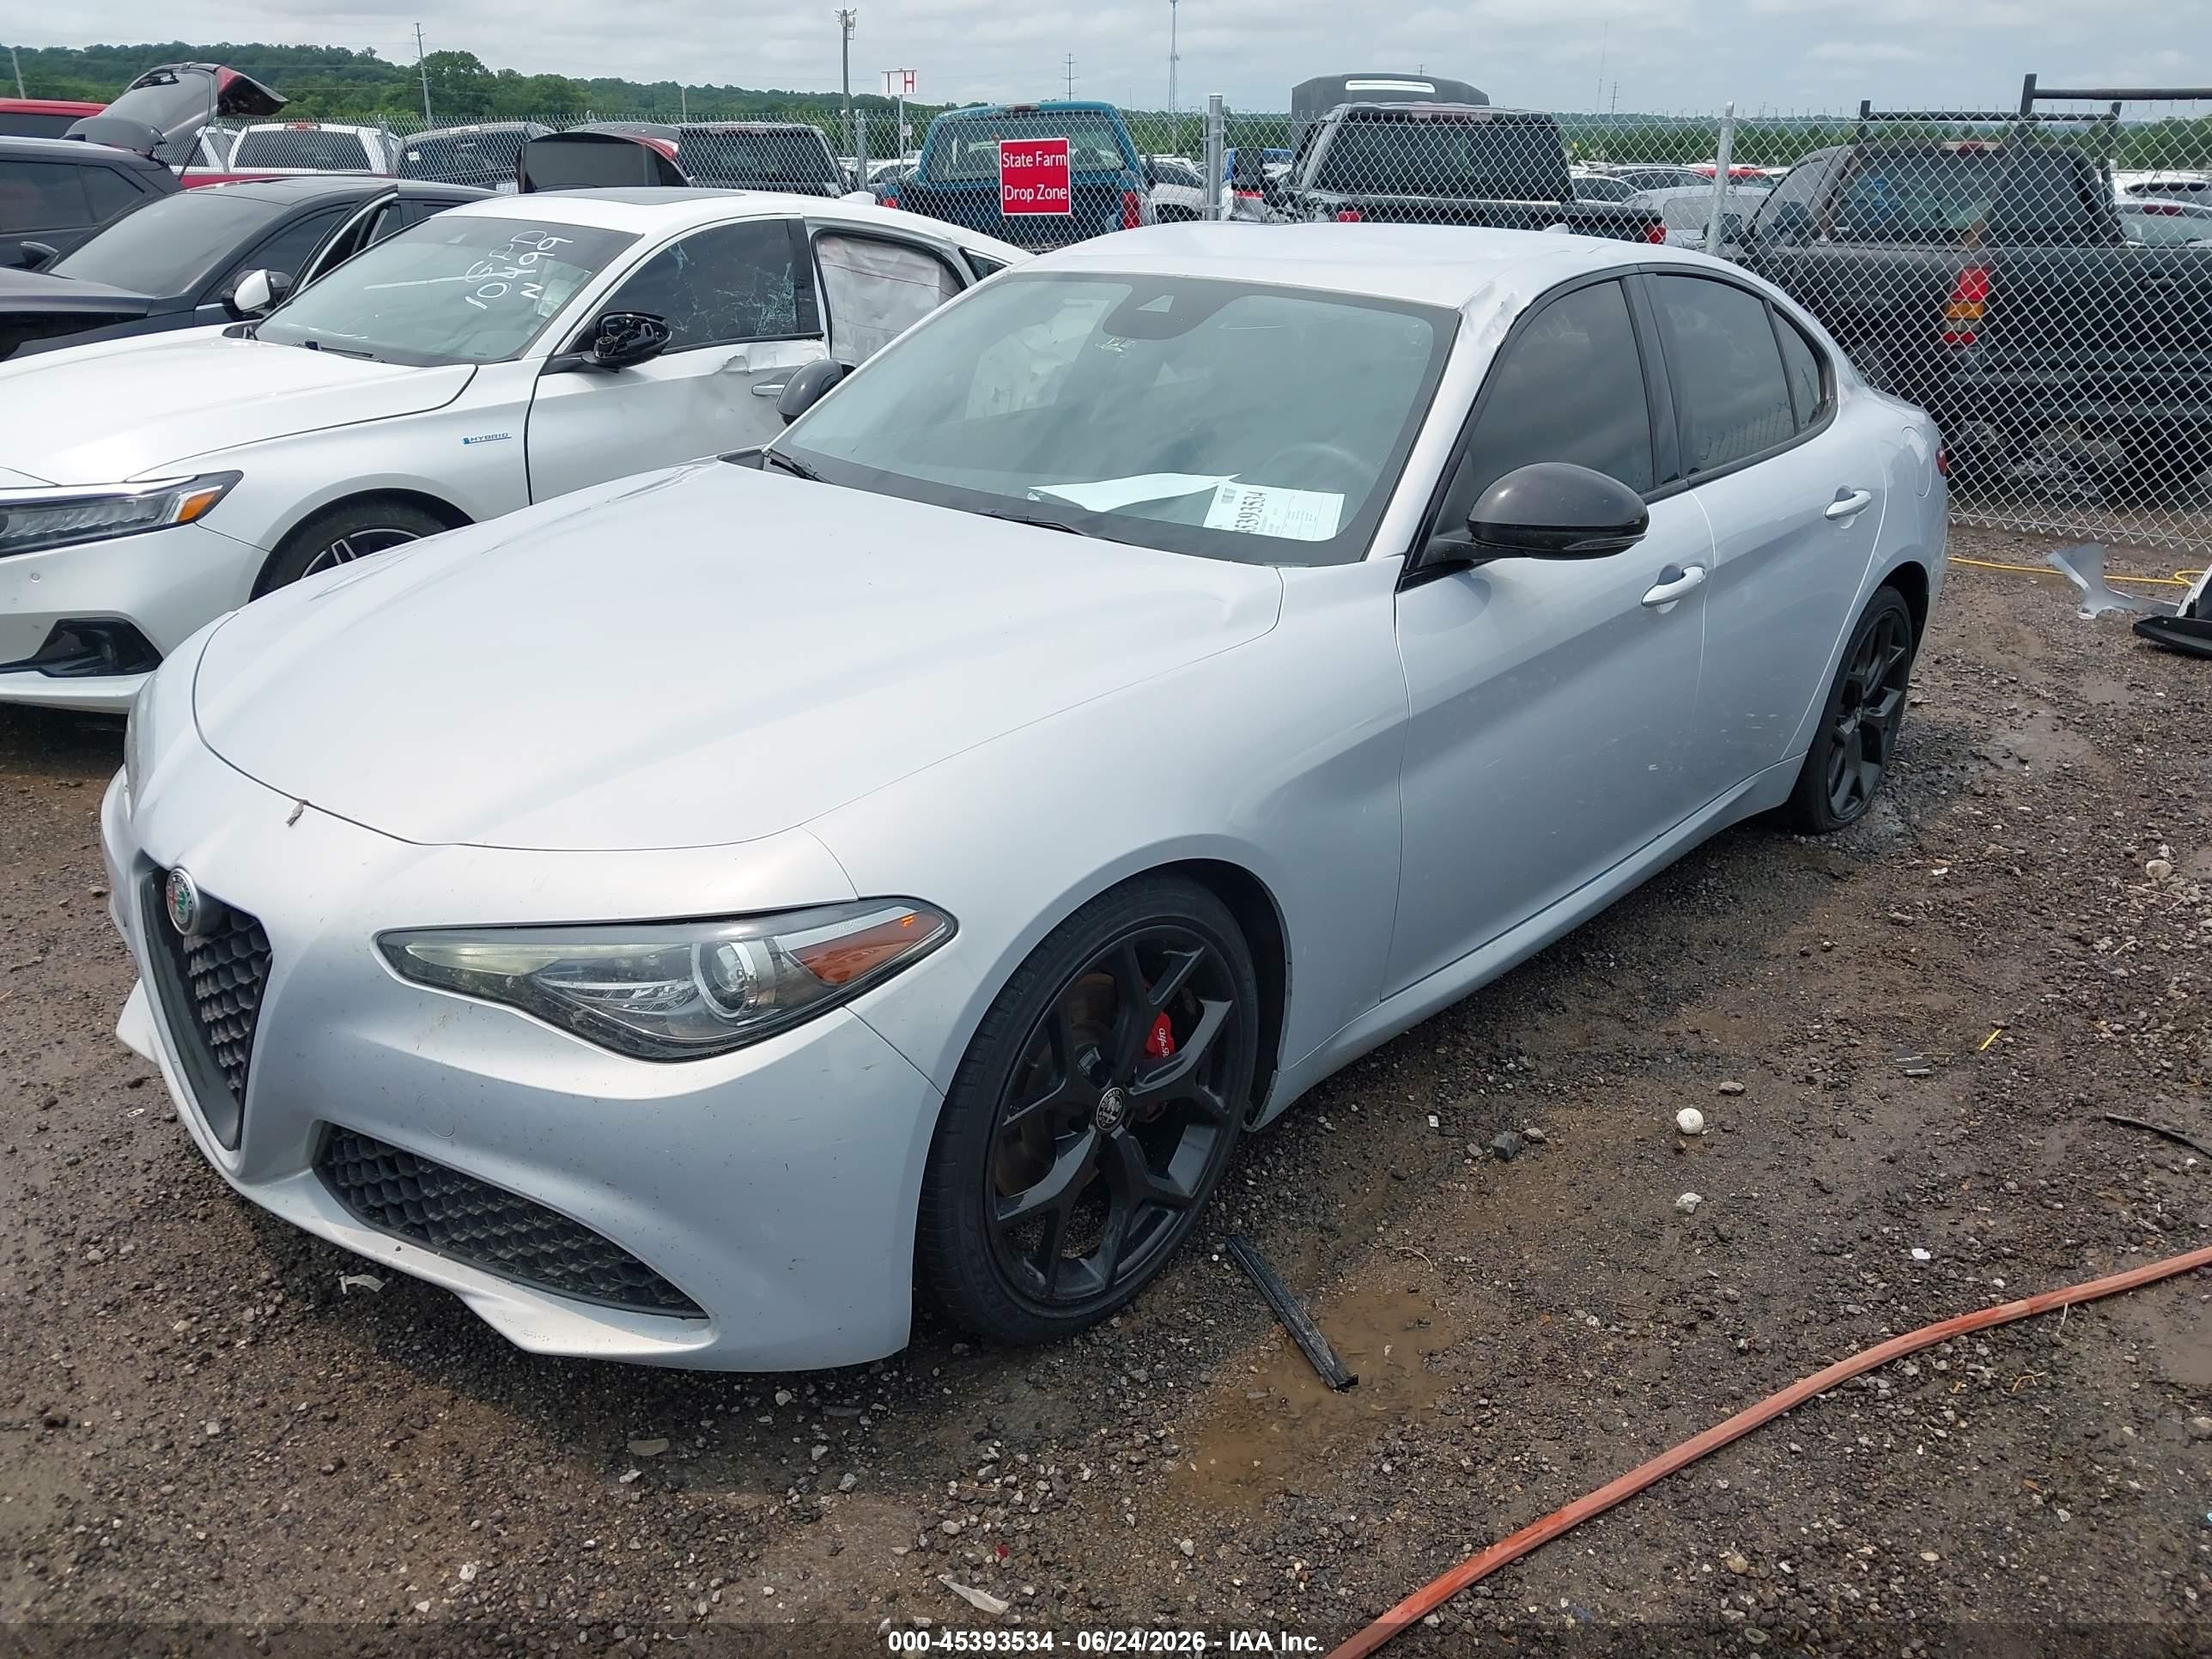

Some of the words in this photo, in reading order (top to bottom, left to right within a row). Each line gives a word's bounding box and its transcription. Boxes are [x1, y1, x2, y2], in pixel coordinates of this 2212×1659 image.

[903, 71, 915, 94] H
[1002, 152, 1033, 168] State
[1036, 150, 1066, 167] Farm
[1004, 185, 1034, 204] Drop
[1036, 183, 1067, 200] Zone
[471, 432, 508, 442] HYBRID
